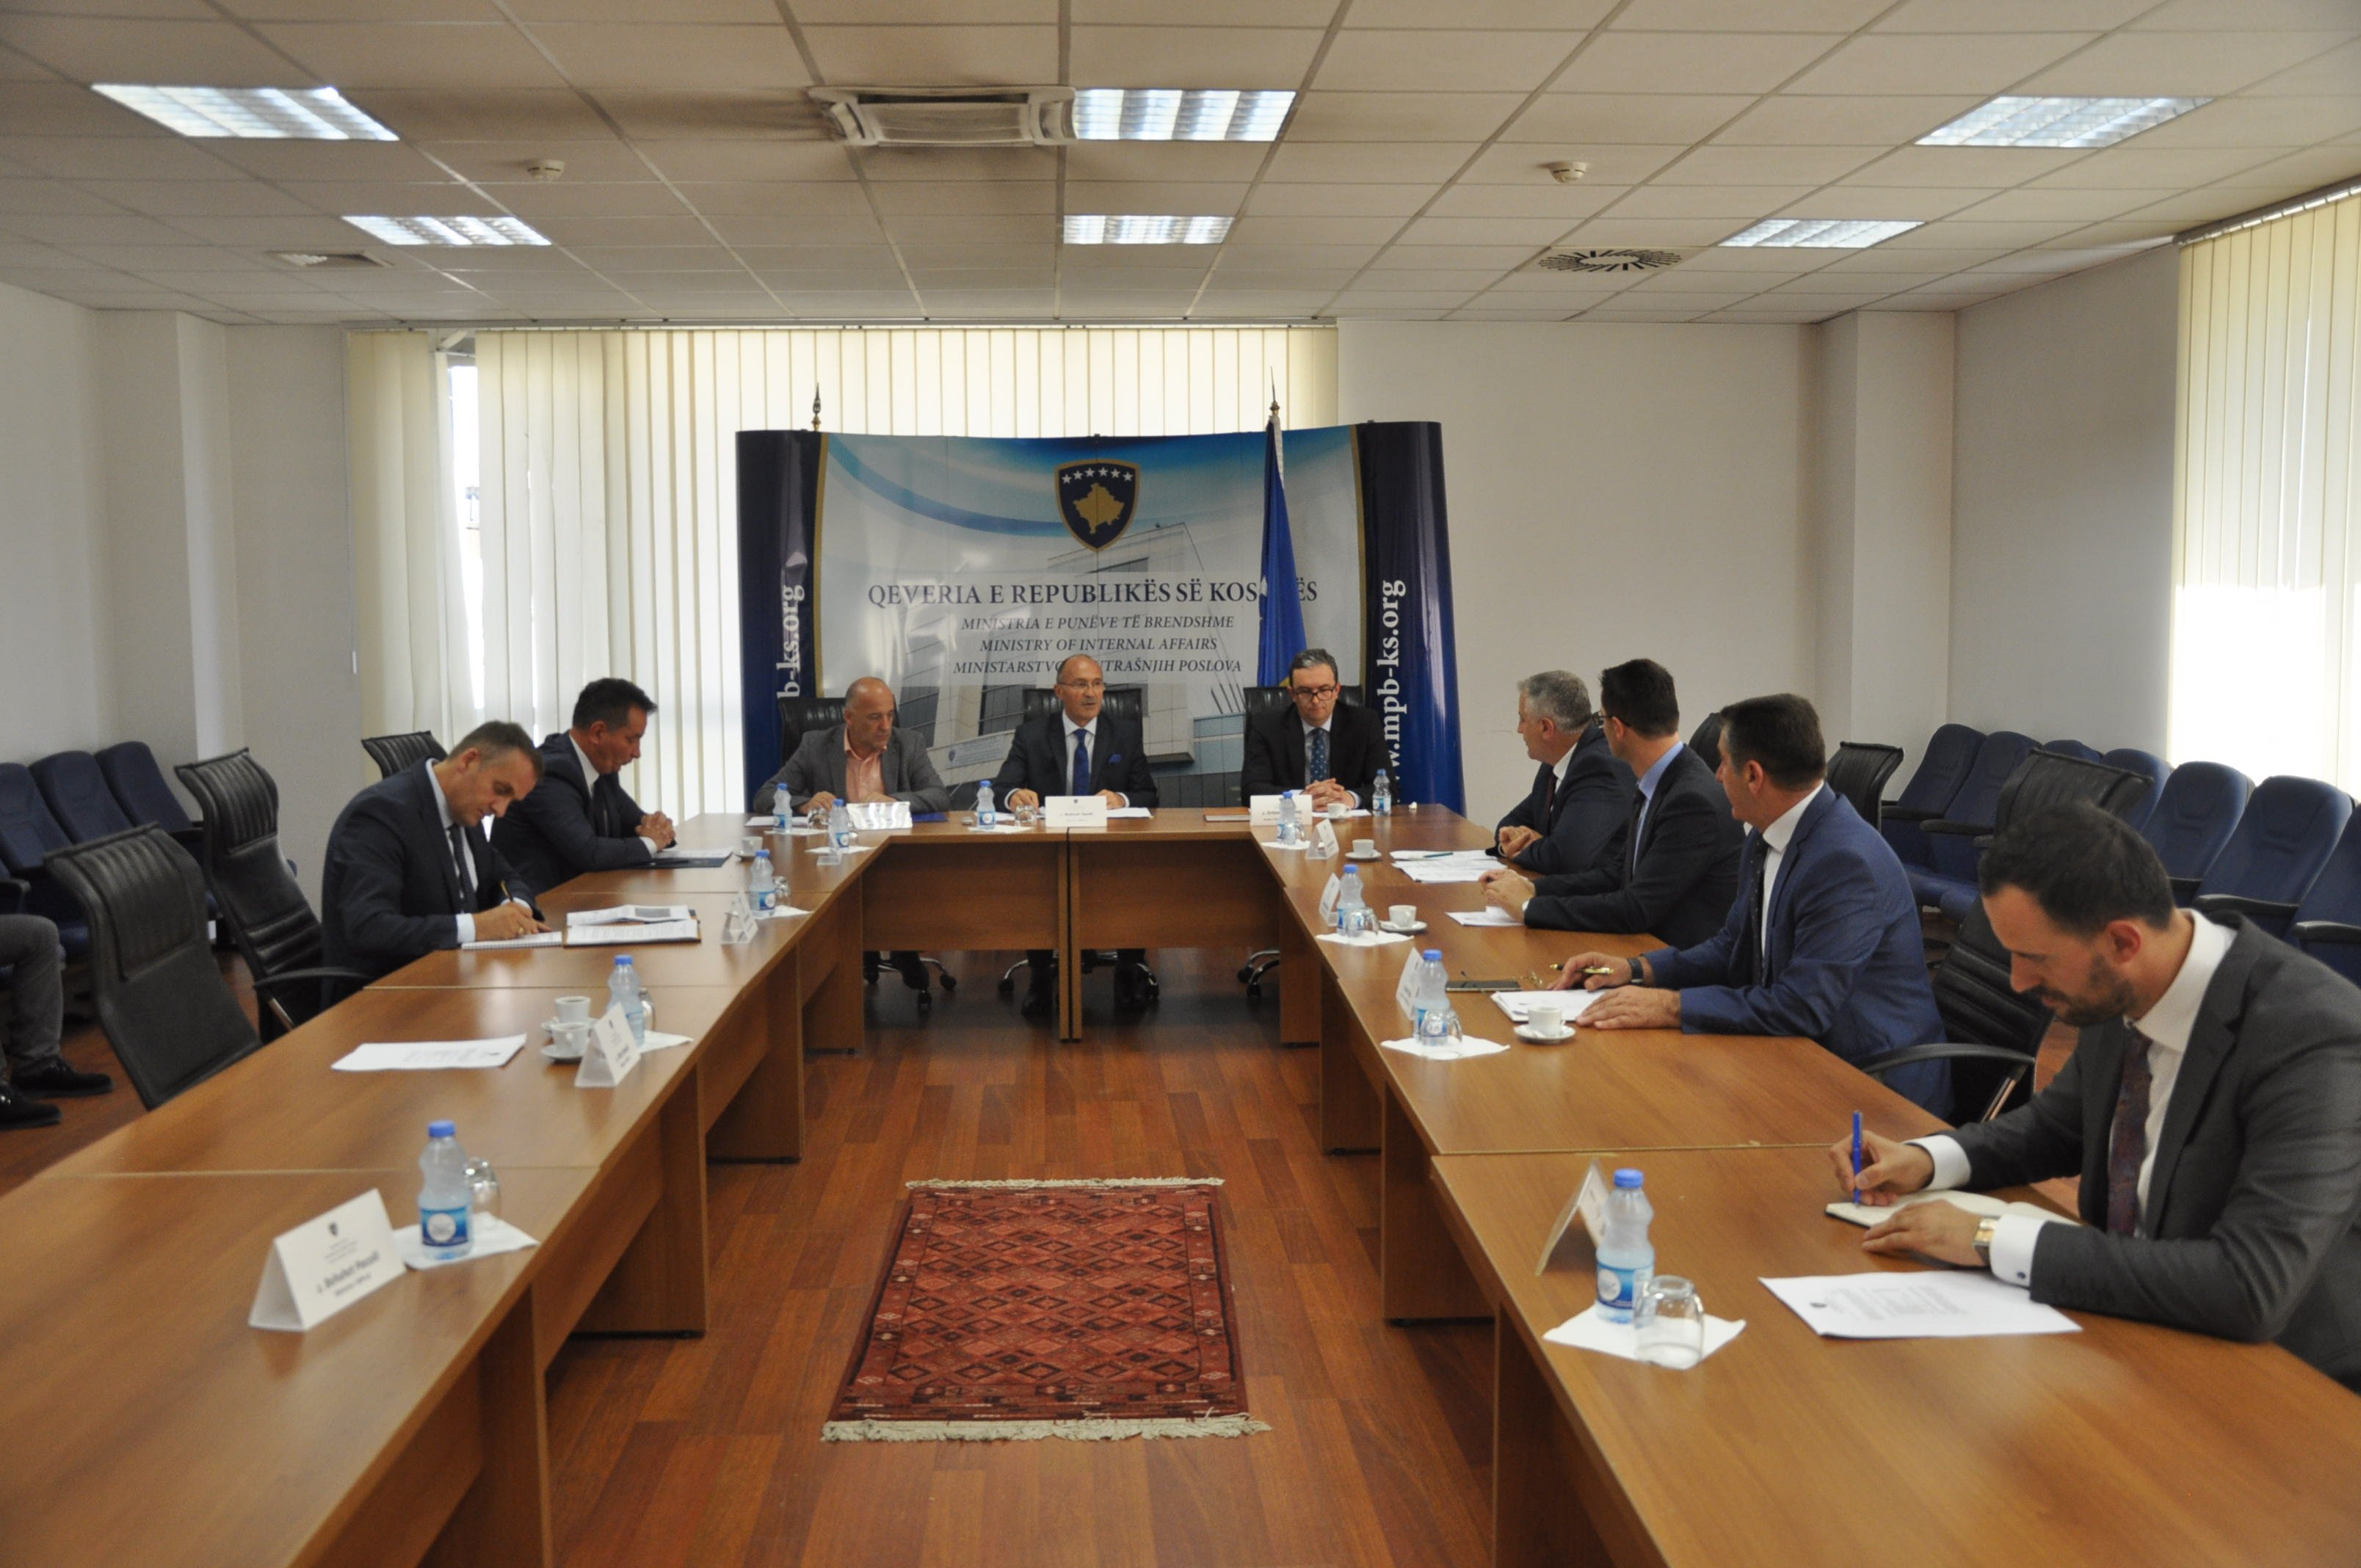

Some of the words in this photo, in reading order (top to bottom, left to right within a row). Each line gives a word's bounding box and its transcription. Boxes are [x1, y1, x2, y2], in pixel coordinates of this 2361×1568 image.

[868, 584, 982, 609] QEVERIA
[990, 585, 1004, 604] E
[1011, 578, 1171, 604] REPUBLIKËS
[1176, 578, 1204, 603] SË
[1209, 577, 1318, 603] KOSËS
[962, 618, 1040, 630] MINISTRIA
[1045, 617, 1054, 629] E
[1057, 614, 1118, 629] PUNËVE
[1123, 614, 1140, 628] TË
[1144, 615, 1234, 628] BRENDSHME
[980, 639, 1053, 651] MINISTRY
[1056, 639, 1077, 651] OF
[1079, 638, 1155, 651] INTERNAL
[1159, 637, 1217, 650] AFFAIRS
[1100, 656, 1175, 672] TRAŠNJIH
[1178, 660, 1241, 672] POSLOVA
[1377, 579, 1407, 803] w.mpb-ks.org
